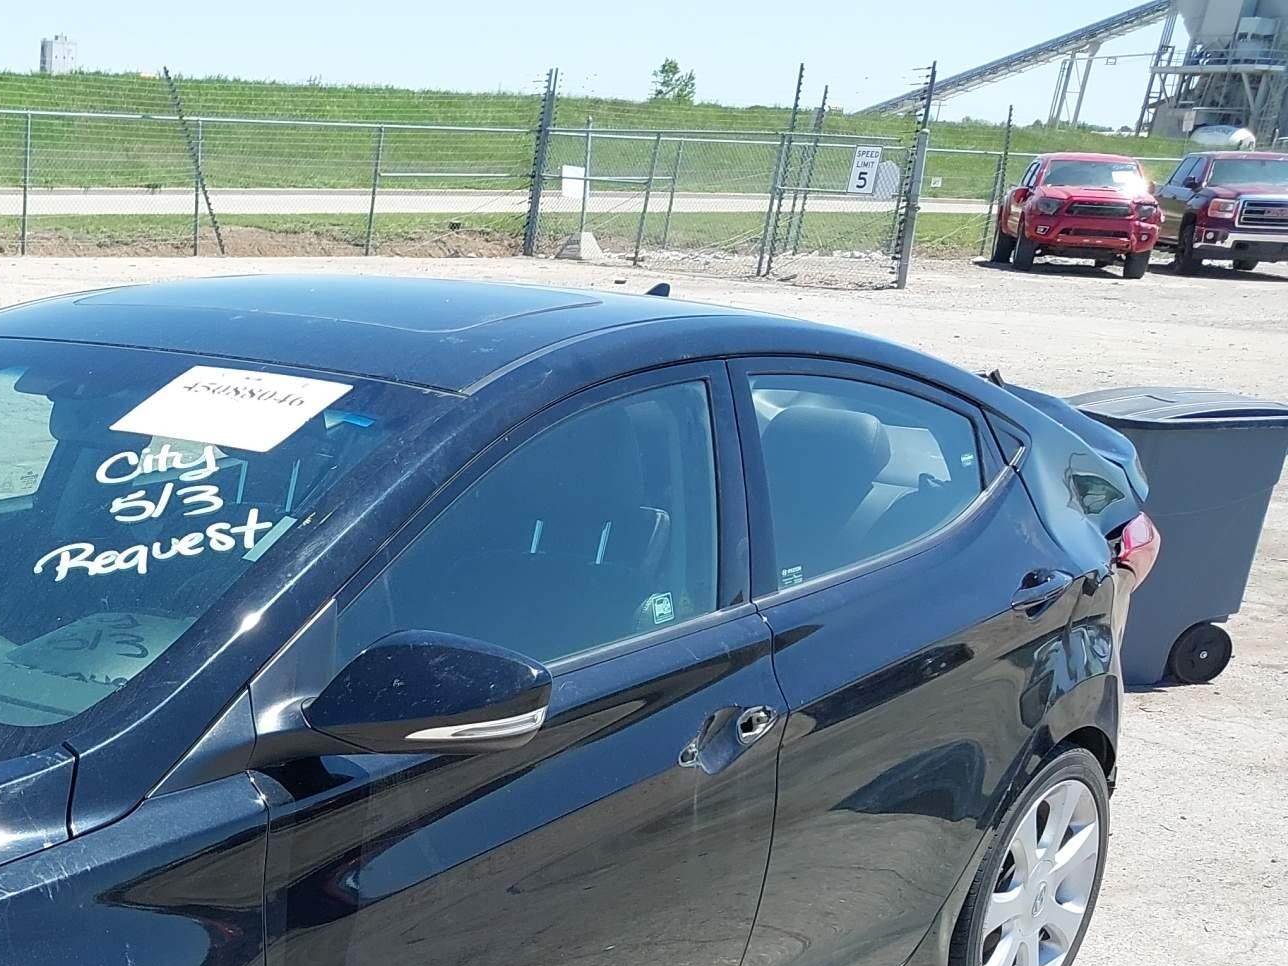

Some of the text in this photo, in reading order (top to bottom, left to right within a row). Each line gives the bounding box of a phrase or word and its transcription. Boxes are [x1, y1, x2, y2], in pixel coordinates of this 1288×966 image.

[856, 172, 868, 188] 5
[96, 445, 220, 481] City
[110, 483, 223, 522] 5/3
[34, 508, 272, 581] Request
